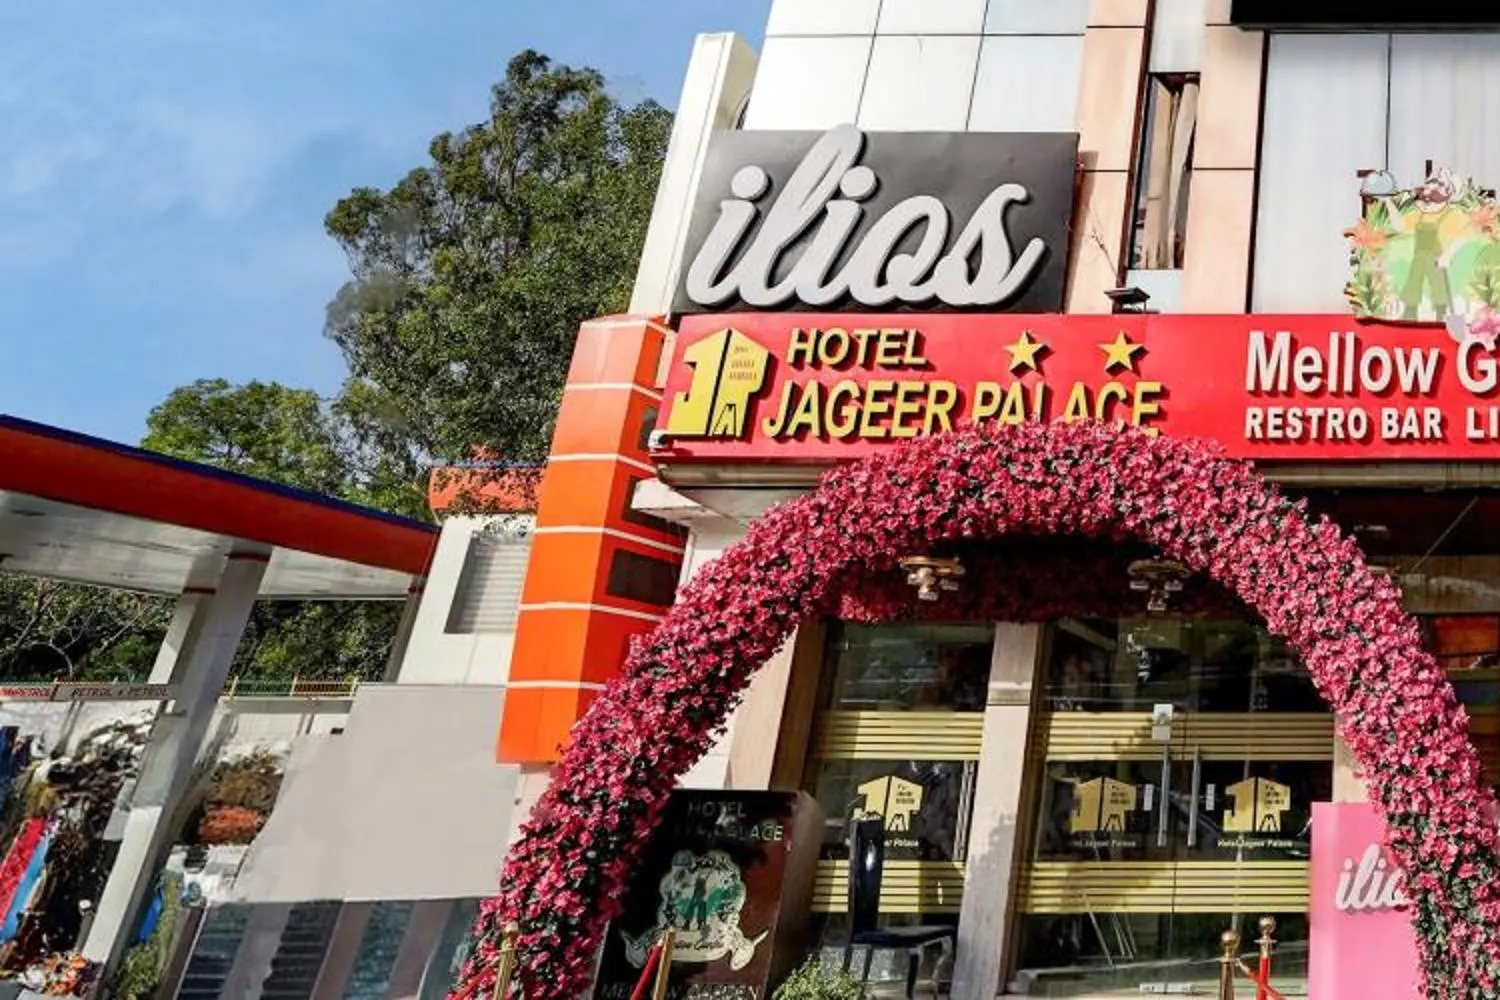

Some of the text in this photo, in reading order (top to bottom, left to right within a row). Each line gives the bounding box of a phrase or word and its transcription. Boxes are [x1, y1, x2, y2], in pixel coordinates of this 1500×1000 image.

[686, 122, 1044, 307] ilios
[786, 327, 929, 366] HOTEL
[1246, 330, 1441, 395] Mellow
[762, 379, 957, 439] JAGEER
[1245, 407, 1368, 439] RESTRO
[1380, 407, 1444, 439] BAR
